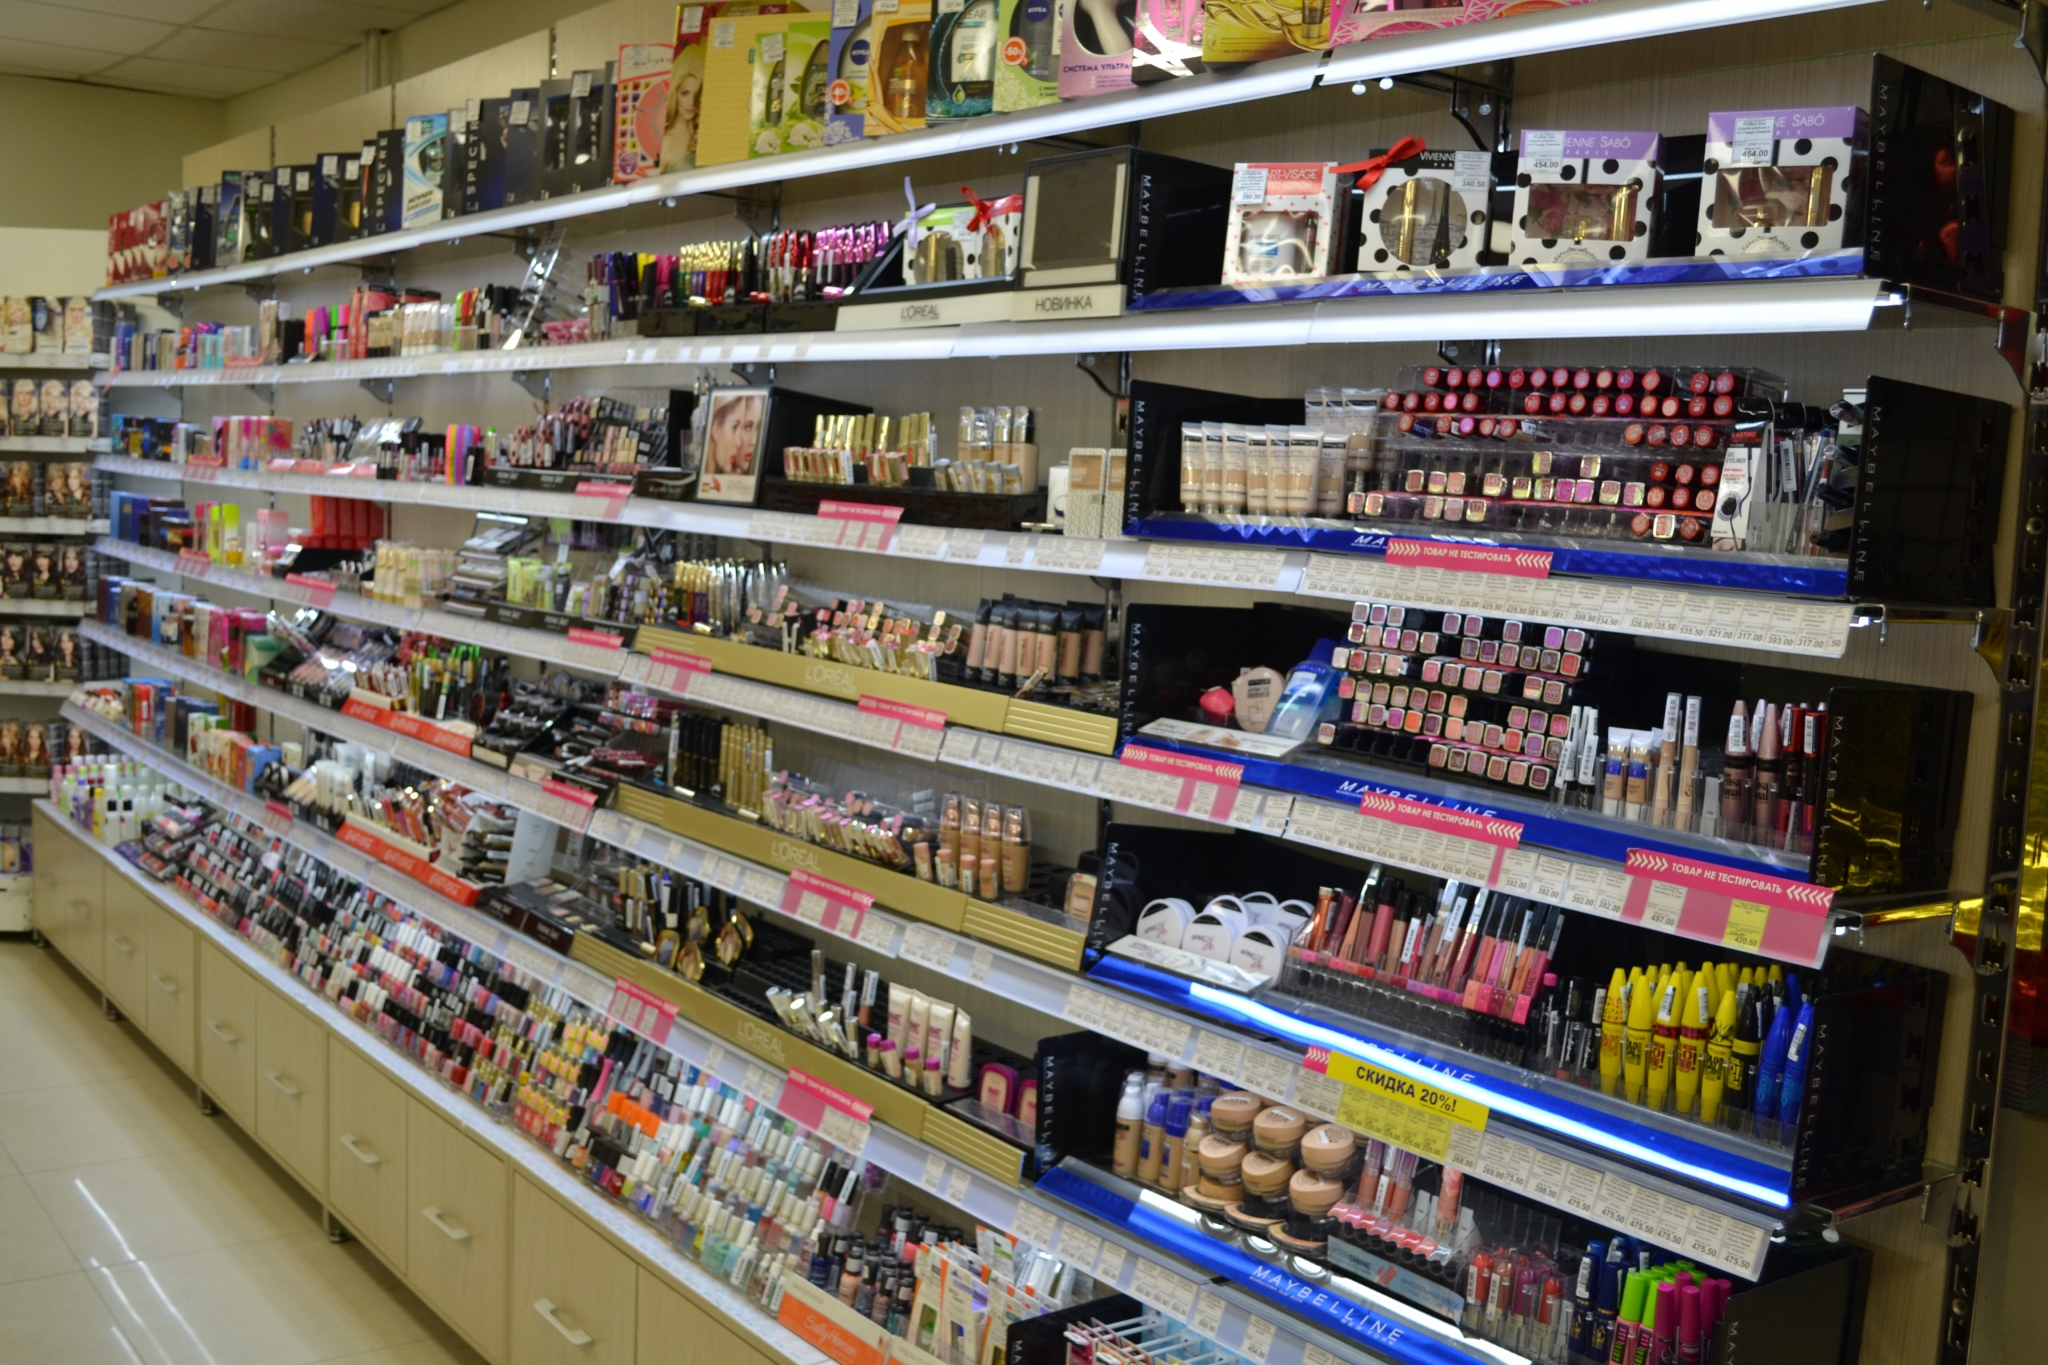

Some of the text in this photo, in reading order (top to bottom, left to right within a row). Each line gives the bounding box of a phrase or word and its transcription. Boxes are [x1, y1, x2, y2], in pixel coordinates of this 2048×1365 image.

[963, 9, 986, 20] LEAR
[1027, 6, 1047, 14] NIVEA
[1063, 64, 1099, 74] СИСТЕМА
[1565, 137, 1595, 148] IENNE
[1742, 149, 1769, 158] 454.00
[1533, 161, 1559, 169] 454.00
[1873, 83, 1888, 262] MAYBELLINE
[1462, 180, 1486, 188] 340.50
[1137, 174, 1152, 307] MAYBELLINE
[1035, 296, 1093, 312] НОВИНКА
[1130, 400, 1145, 524] MAYBELLINE
[1856, 405, 1882, 582] MAYBELLINE
[1424, 547, 1512, 564] ТОВАР НЕ ТЕСТИРОВАТЬ
[1482, 602, 1502, 611] 425.50
[1506, 606, 1528, 614] 425.50
[1574, 614, 1596, 622] 399.50
[1630, 620, 1652, 630] 326.00
[1680, 628, 1704, 638] 535.50
[1708, 630, 1733, 640] 521.00
[1737, 632, 1763, 642] 317.00
[1768, 636, 1794, 646] 393.00
[1798, 638, 1824, 649] 317.00
[1818, 716, 1844, 884] MAYBELLINE
[1397, 804, 1484, 830] ТОВАР НЕ ТЕСТИРОВАТЬ
[1294, 828, 1312, 837] 425.50
[1376, 849, 1395, 860] 425.50
[1419, 860, 1438, 870] 425.50
[1442, 865, 1462, 876] 425.50
[1465, 870, 1486, 881] 425.50
[1672, 862, 1782, 894] ТОВАР НЕ ТЕСТИРОВАТЬ
[1506, 879, 1528, 890] 392.00
[1538, 888, 1560, 899] 392.00
[1572, 895, 1594, 906] 392.00
[1598, 900, 1621, 913] 392.00
[1650, 914, 1676, 926] 497.00
[1734, 936, 1758, 948] 420.50
[1356, 1066, 1457, 1112] СКИДКА 20%!
[1795, 1024, 1828, 1189] MAYBELLINE
[1345, 1115, 1363, 1128] 225.00
[1364, 1121, 1382, 1134] 225.00
[1382, 1128, 1401, 1142] 225.00
[1402, 1136, 1422, 1150] 225.00
[1422, 1143, 1442, 1156] 225.00
[1452, 1154, 1474, 1168] 268.00
[1482, 1166, 1505, 1180] 268.00
[1505, 1172, 1524, 1186] 75.50
[1534, 1184, 1557, 1199] 398.50
[1567, 1198, 1591, 1212] 475.50
[1601, 1208, 1625, 1224] 475.50
[1629, 1220, 1654, 1235] 475.50
[1656, 1230, 1682, 1245] 475.50
[1691, 1242, 1717, 1258] 475.50
[1724, 1254, 1750, 1270] 475.50
[1253, 1265, 1404, 1343] MAYBELLINE
[1340, 1318, 1395, 1346] NEW YORK
